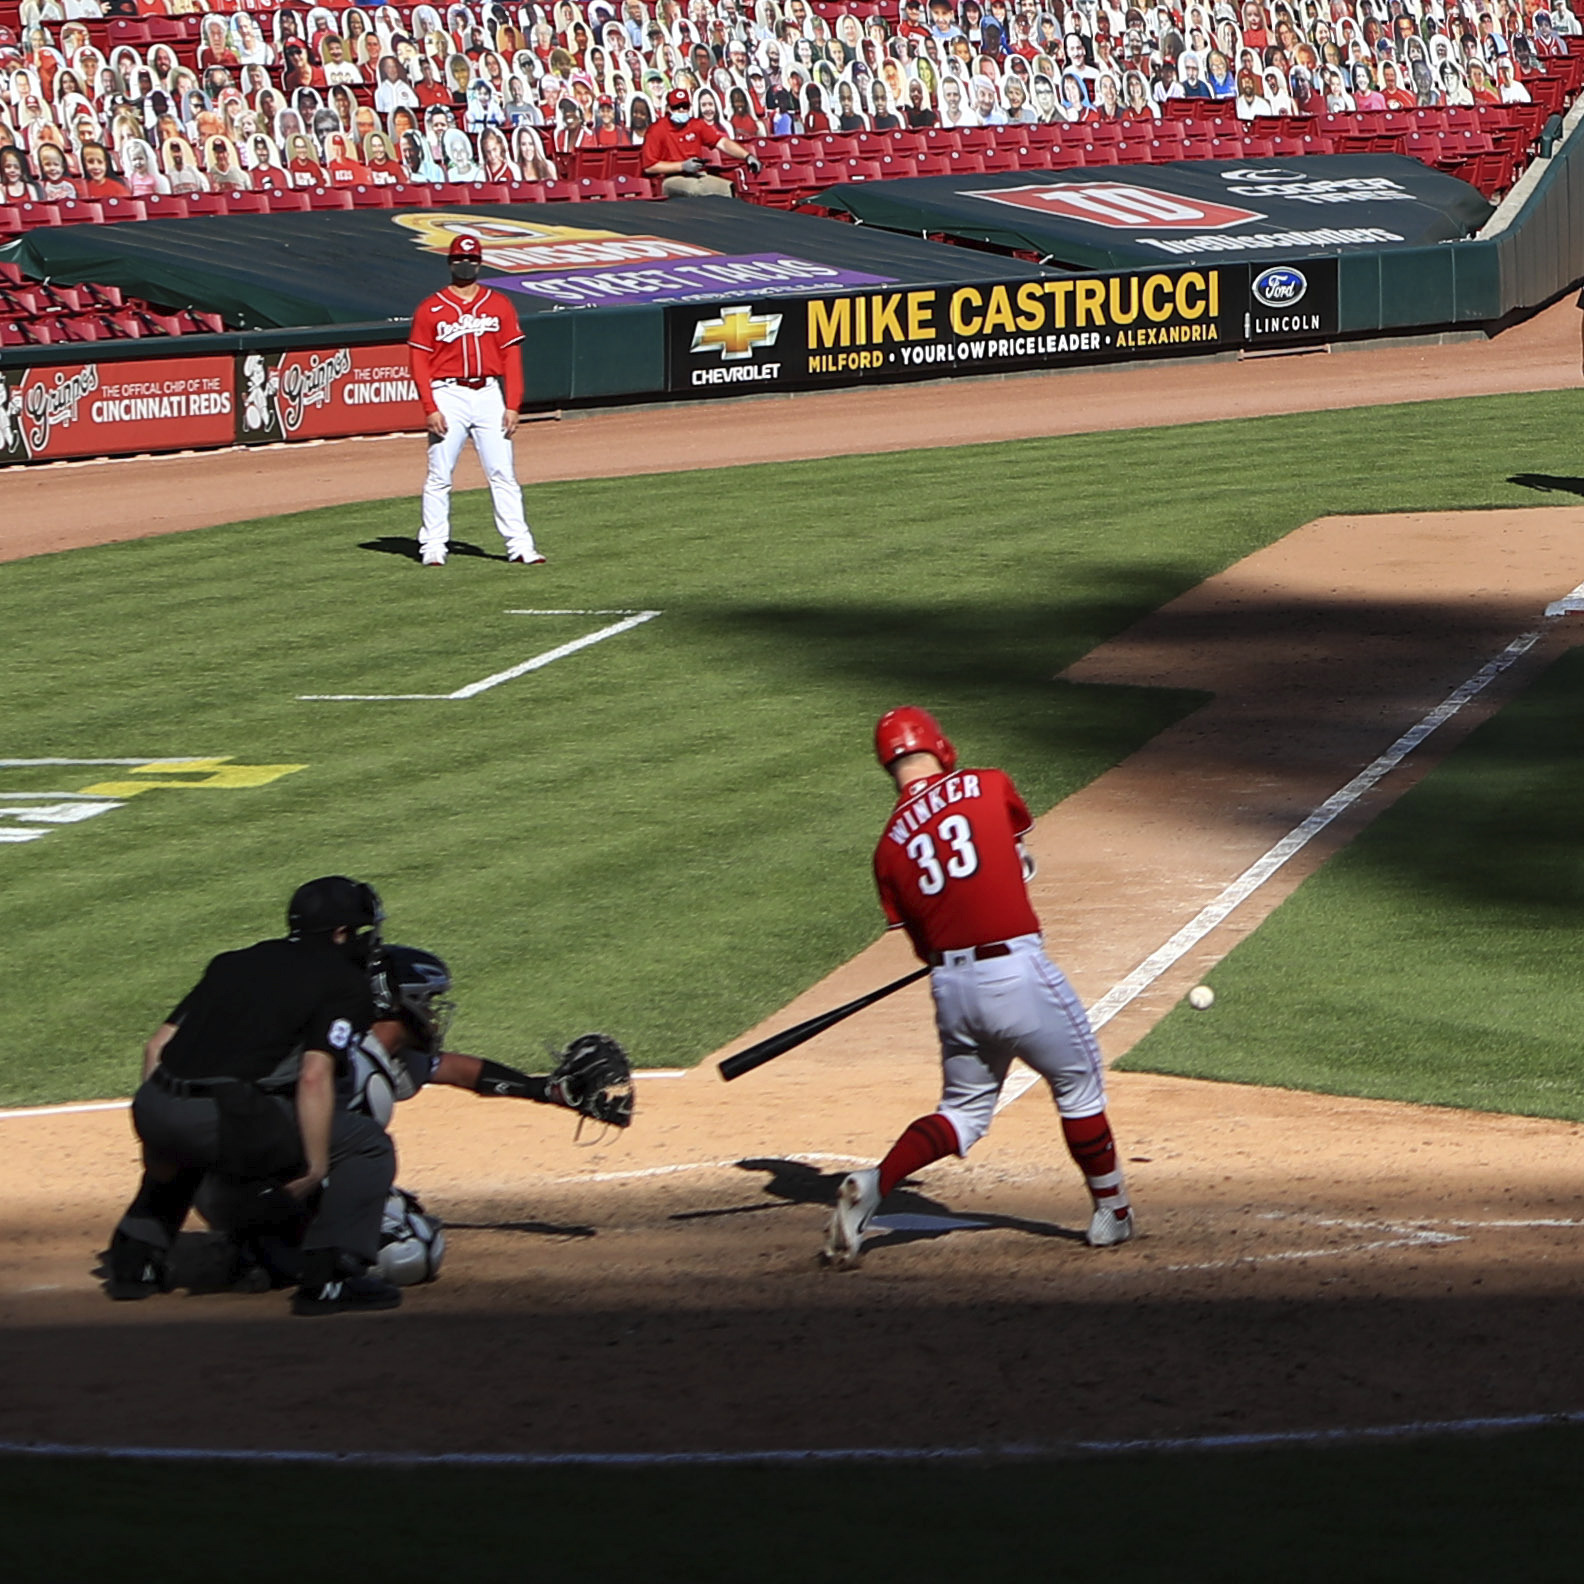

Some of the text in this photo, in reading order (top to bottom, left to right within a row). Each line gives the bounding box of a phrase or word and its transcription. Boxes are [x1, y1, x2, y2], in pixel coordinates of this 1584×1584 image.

[1226, 178, 1406, 197] COOPER
[1285, 190, 1418, 205] TIRES
[1136, 227, 1405, 255] TireDiscounters
[519, 269, 704, 303] STREET
[701, 260, 840, 284] TACOS
[1265, 273, 1294, 300] Ford
[806, 270, 1220, 350] MIKE CASTRUCCI
[1254, 313, 1321, 334] LINCOLN
[807, 352, 883, 374] MILFORD
[1115, 323, 1219, 348] ALEXANDRIA
[353, 366, 372, 381] THE
[691, 362, 781, 386] CHEVROLET
[102, 384, 120, 399] THE
[163, 380, 185, 395] CHIP
[187, 379, 200, 392] OF
[202, 377, 221, 392] THE
[343, 379, 420, 406] CINCINNA
[91, 391, 231, 423] CINCINNATI REDS
[887, 774, 981, 845] WINKER
[906, 814, 979, 896] 33
